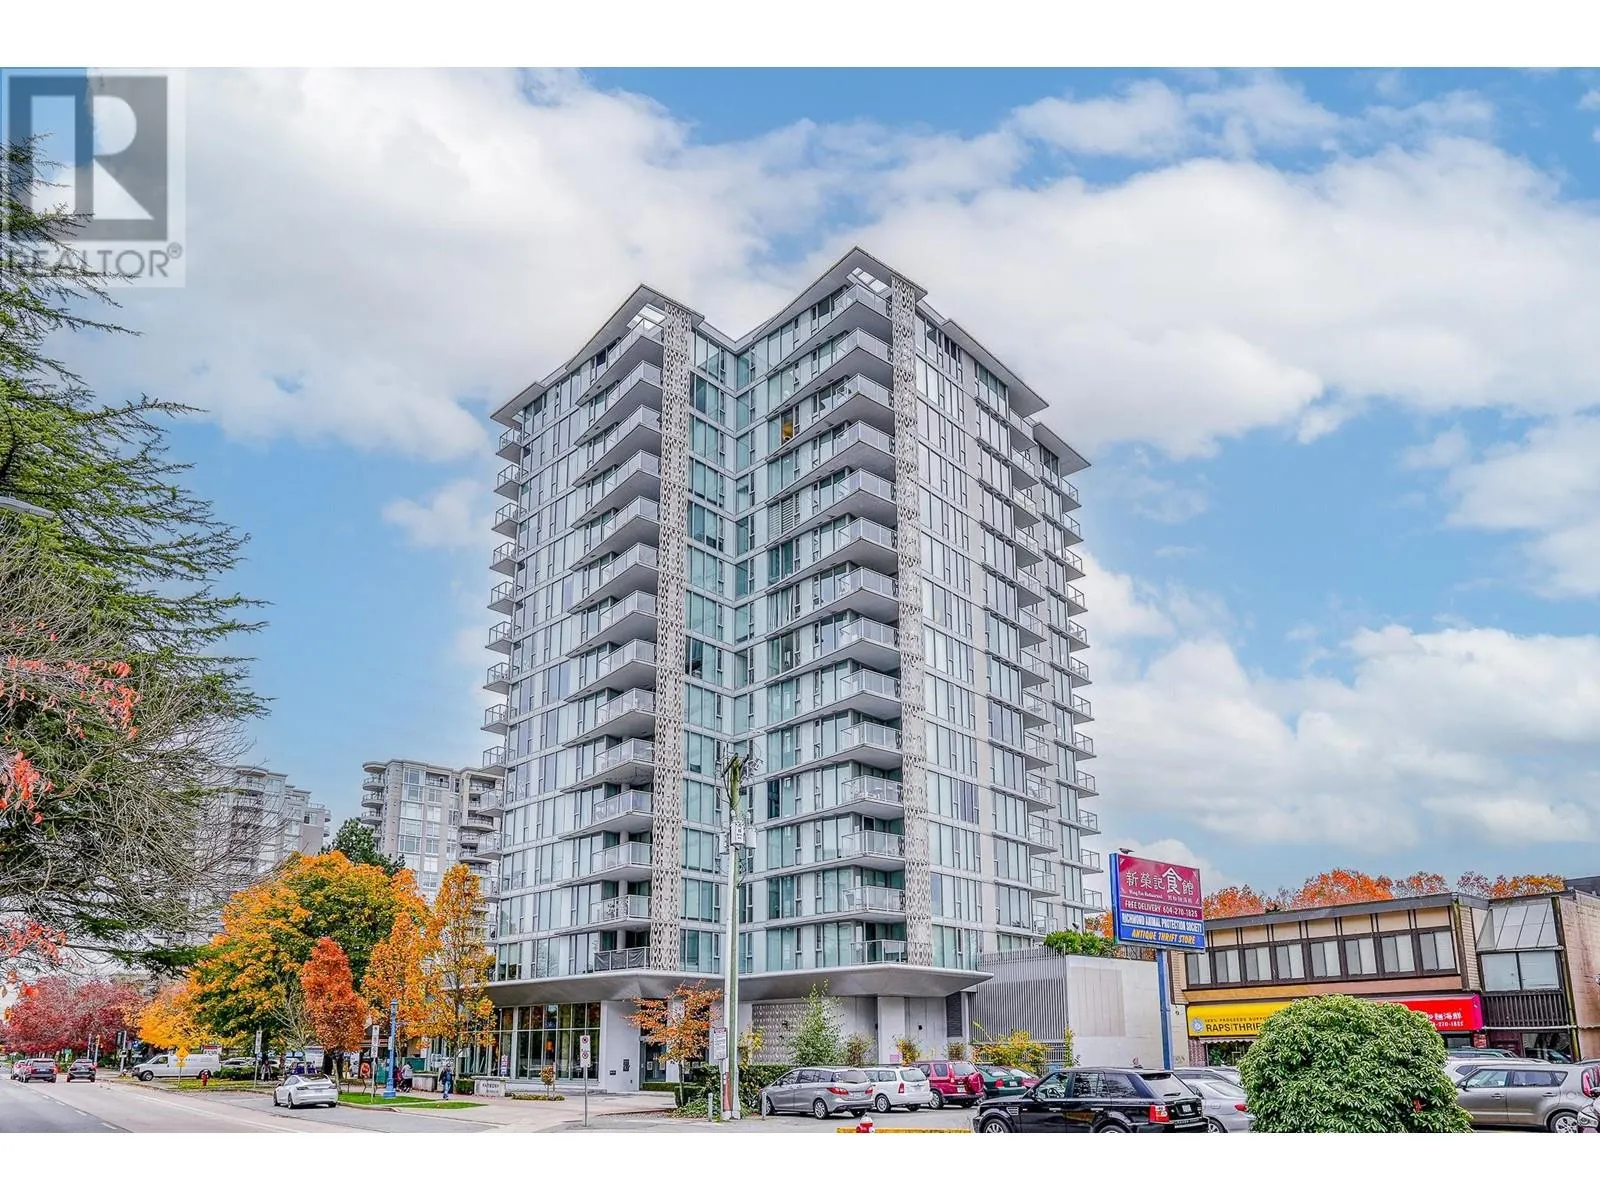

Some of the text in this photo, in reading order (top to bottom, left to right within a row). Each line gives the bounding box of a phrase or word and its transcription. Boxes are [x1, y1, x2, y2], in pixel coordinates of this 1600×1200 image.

[1125, 900, 1137, 909] FREE
[1138, 902, 1161, 912] DELIVERY
[1161, 918, 1186, 930] PROTECTION
[1186, 921, 1202, 932] SOCIETY
[1132, 928, 1196, 945] ANTIQUE THRIFT STORE
[1206, 1022, 1261, 1032] RAPS THRIF
